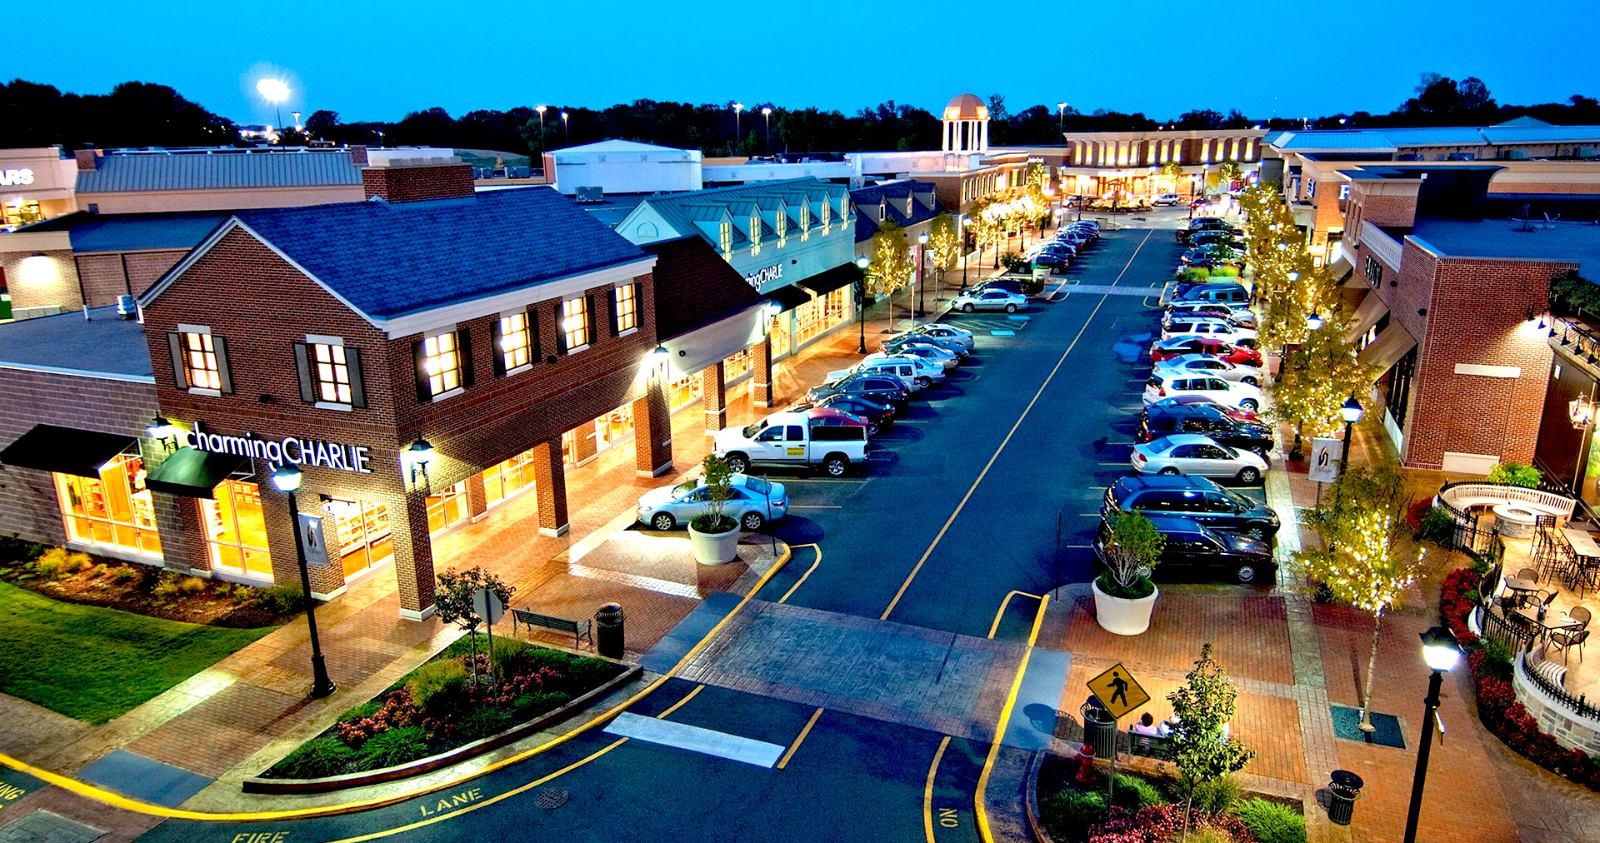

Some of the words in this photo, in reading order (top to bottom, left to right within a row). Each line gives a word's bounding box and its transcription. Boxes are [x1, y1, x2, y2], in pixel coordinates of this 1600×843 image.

[420, 788, 484, 817] LANE
[939, 808, 958, 827] NO
[232, 831, 290, 843] FIRE
